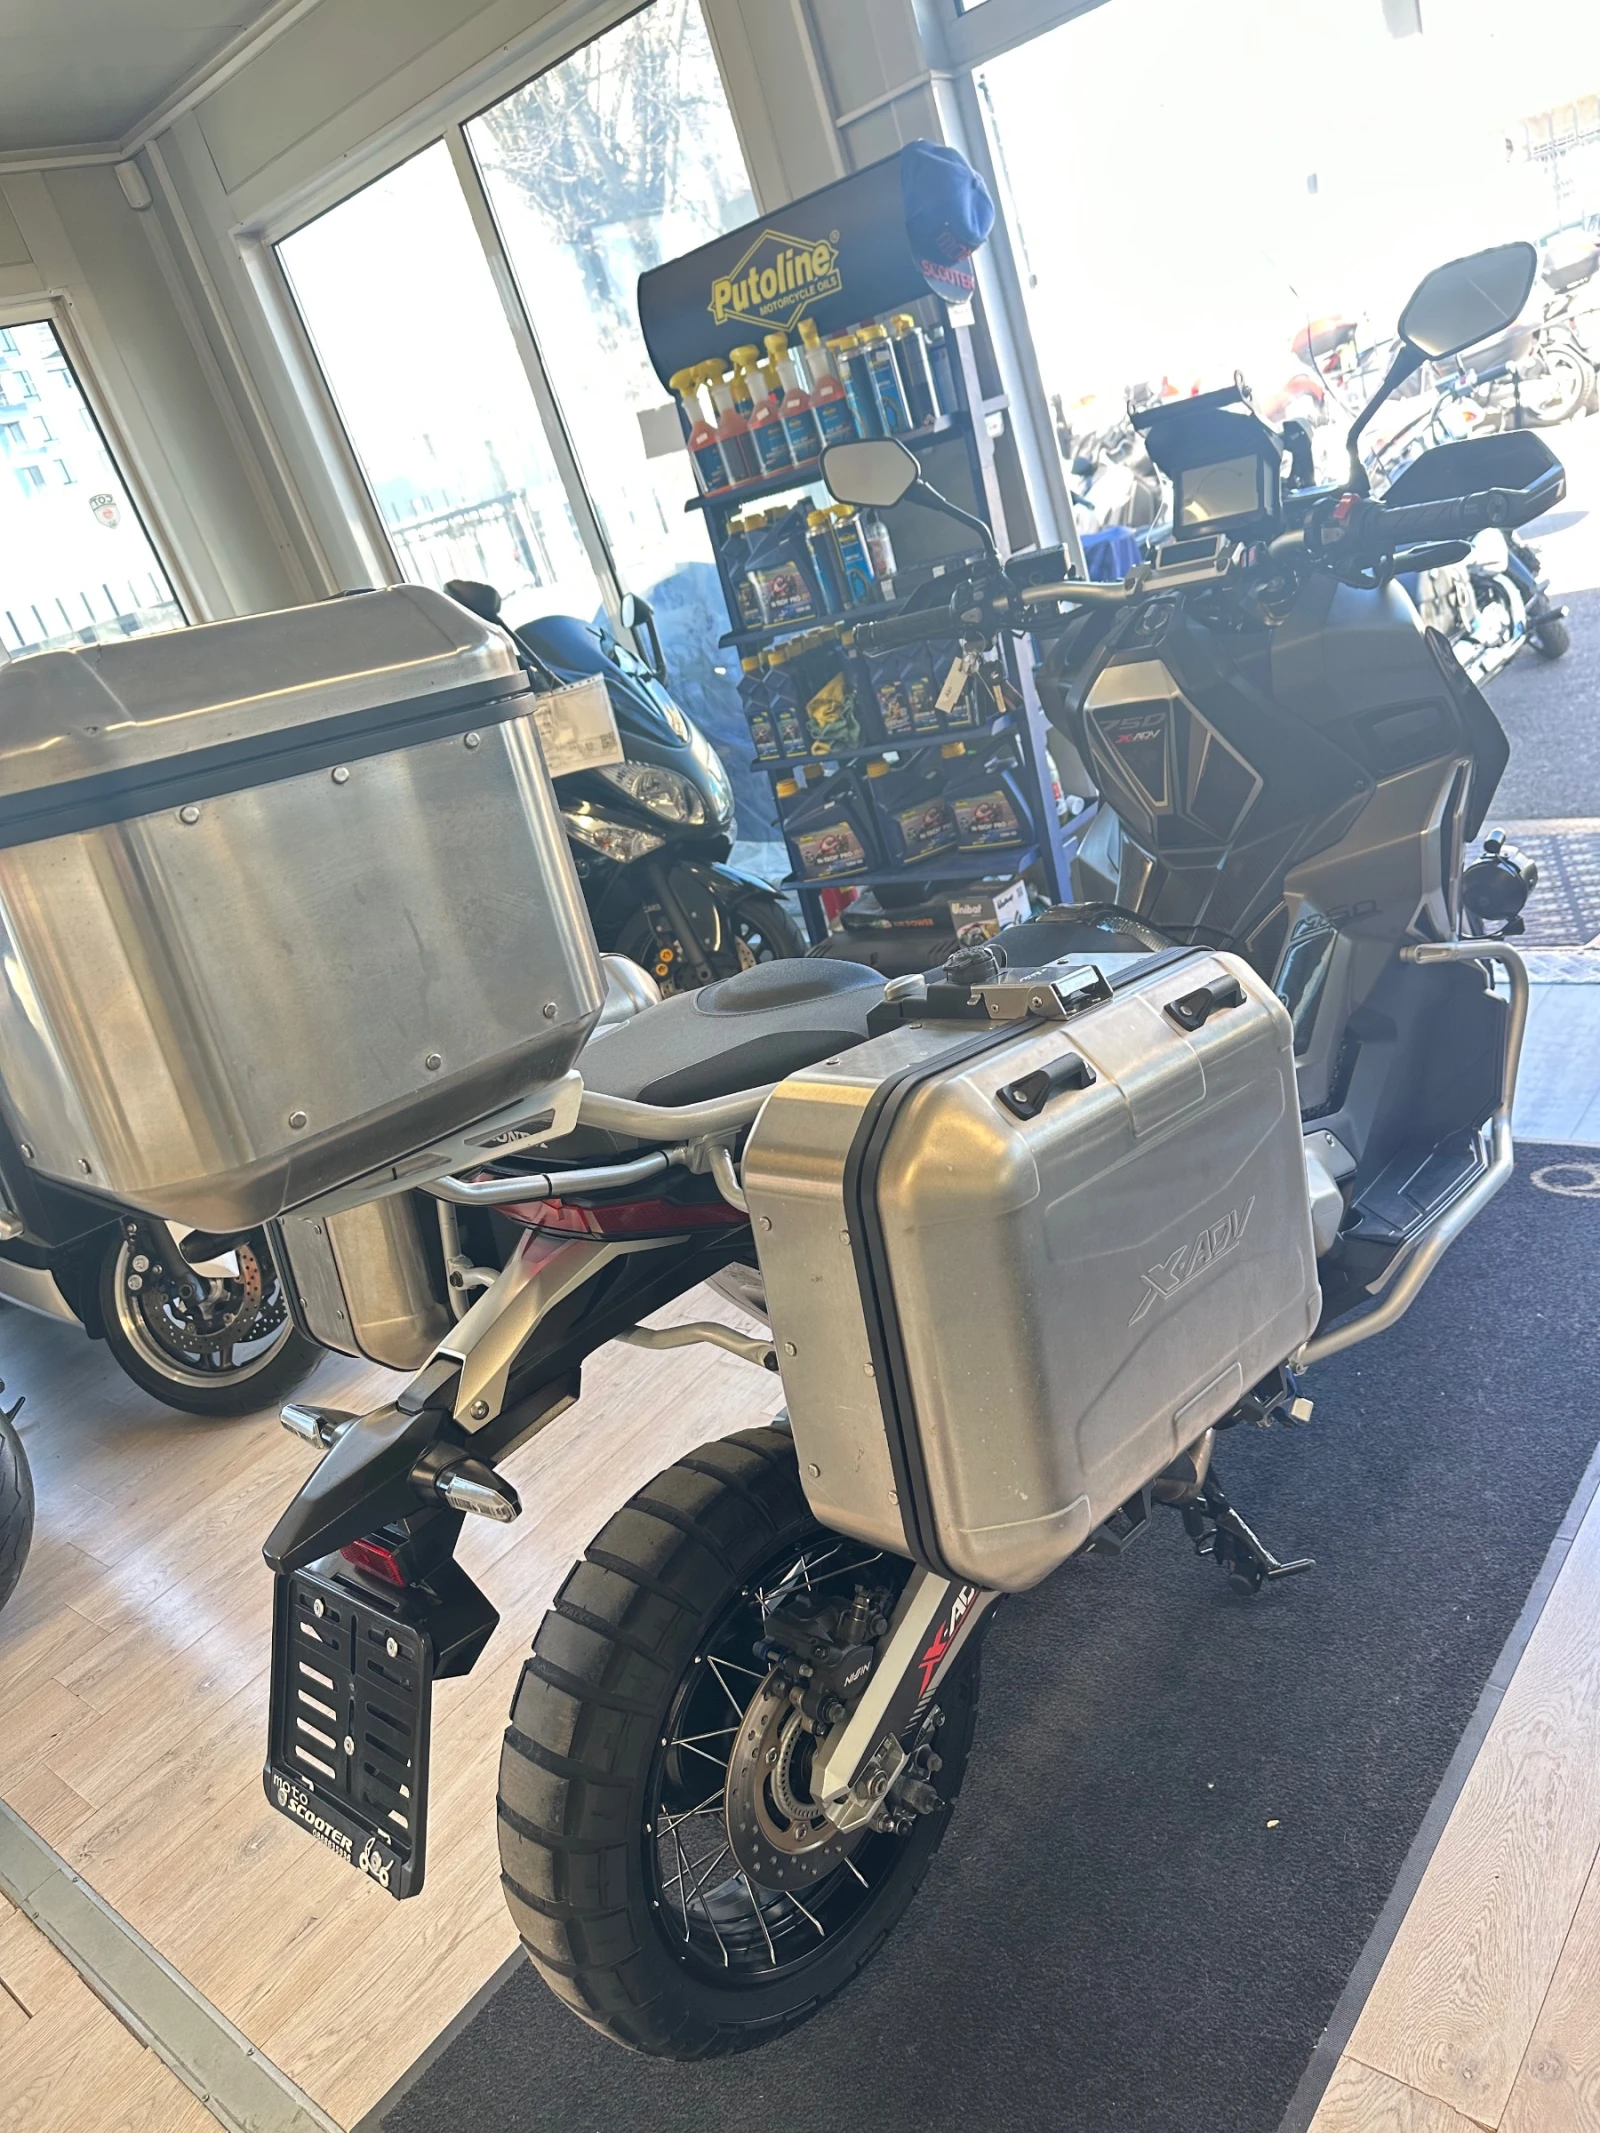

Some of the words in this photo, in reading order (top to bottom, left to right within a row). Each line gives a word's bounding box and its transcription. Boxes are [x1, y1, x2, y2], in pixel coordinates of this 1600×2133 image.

[713, 243, 831, 321] Putoline
[759, 284, 816, 316] MOTORCYCLE
[816, 276, 838, 292] OILS
[1100, 711, 1167, 732] 750
[1114, 728, 1162, 744] X-ADV
[951, 902, 982, 915] Unibat
[1127, 1194, 1256, 1328] X-ADV
[918, 1585, 976, 1699] X-AD
[844, 1660, 872, 1688] NISSIN
[273, 1773, 309, 1806] moto
[287, 1798, 353, 1855] SCOOTER
